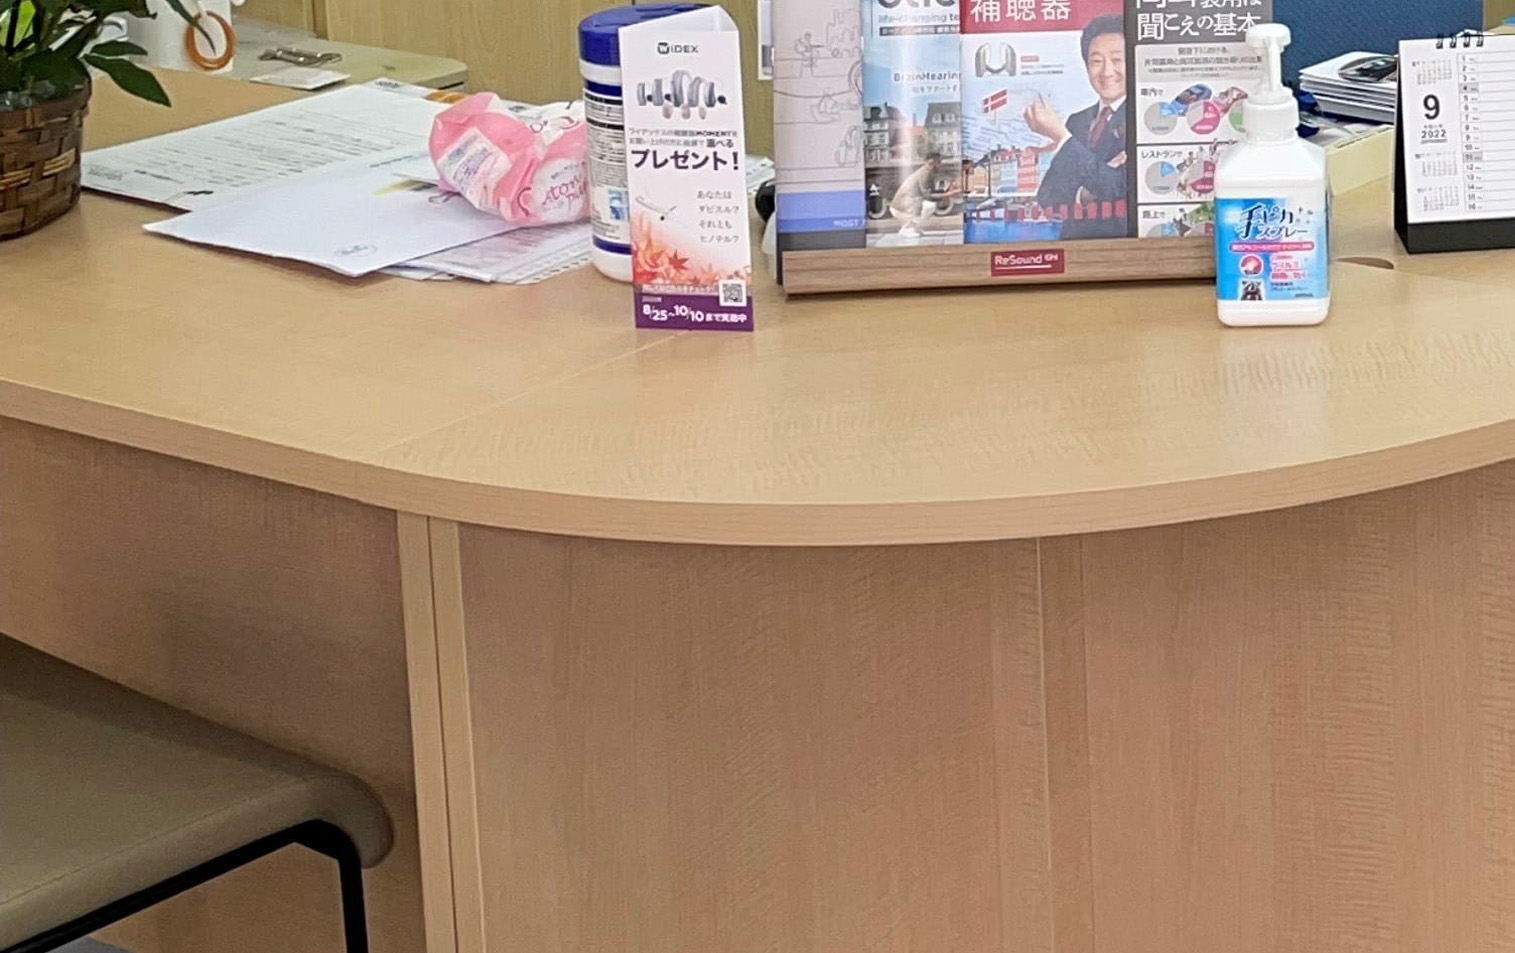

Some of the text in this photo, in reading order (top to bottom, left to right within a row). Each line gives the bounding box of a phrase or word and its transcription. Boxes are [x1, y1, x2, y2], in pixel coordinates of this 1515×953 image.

[1137, 11, 1262, 41] 聞こえの基本
[1423, 94, 1441, 120] 9
[1421, 129, 1447, 139] 2022
[630, 148, 740, 171] プレゼント！
[1258, 226, 1309, 238] スプレー
[994, 254, 1043, 265] ReSound
